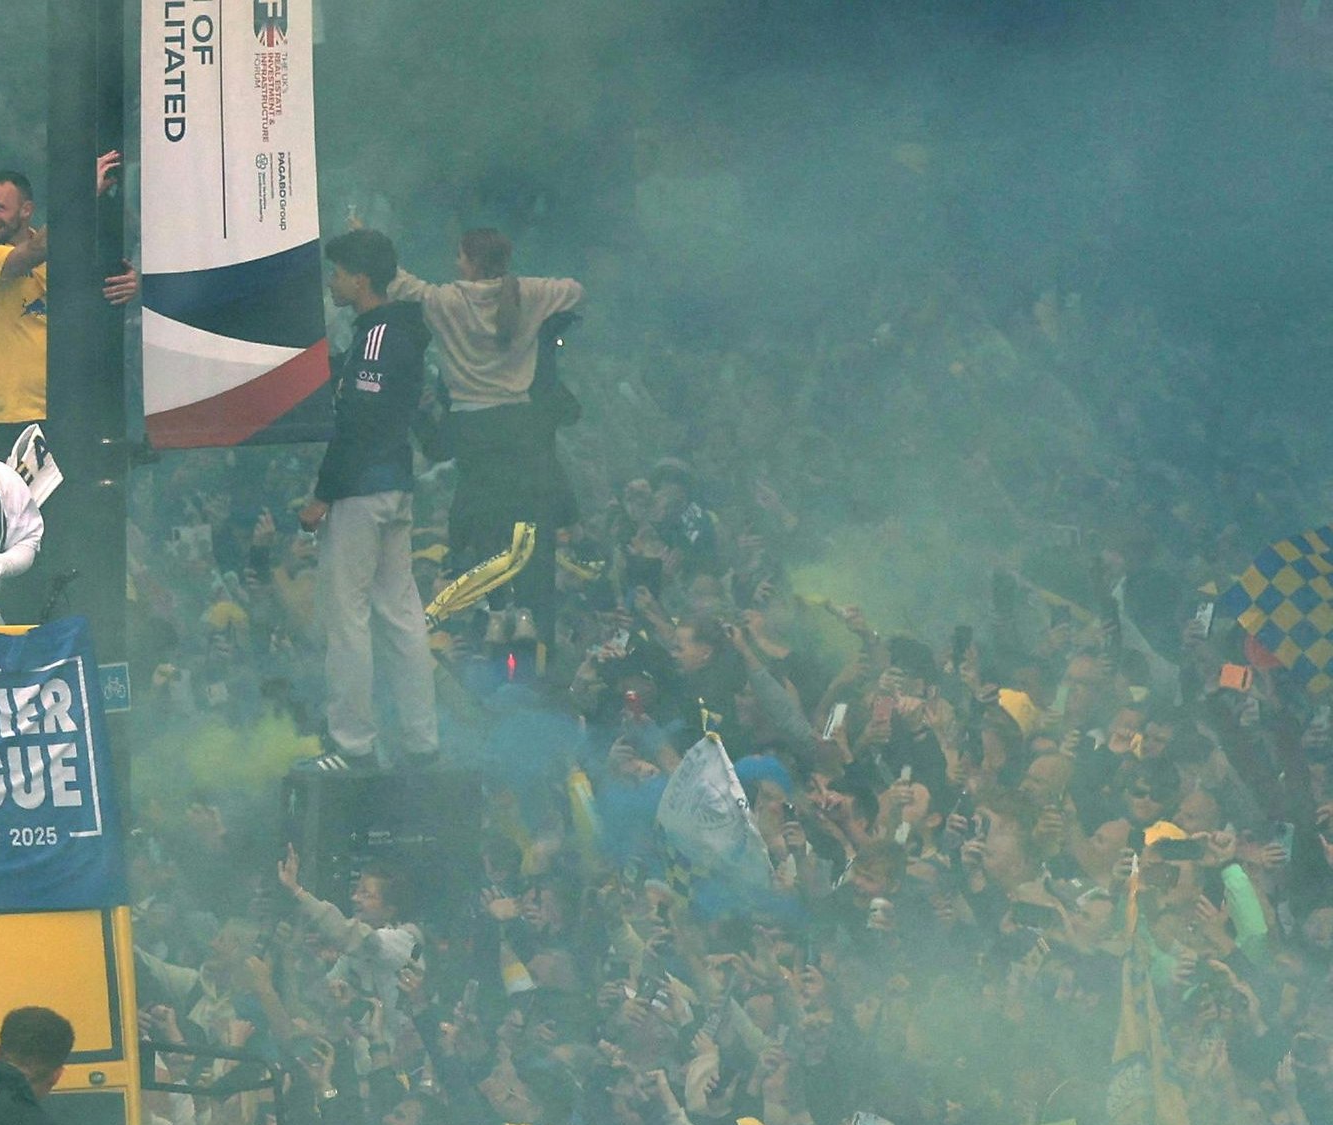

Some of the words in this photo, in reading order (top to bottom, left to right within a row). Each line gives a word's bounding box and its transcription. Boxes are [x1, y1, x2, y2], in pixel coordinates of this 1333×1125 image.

[192, 14, 214, 65] OF
[274, 52, 282, 77] REAL
[261, 52, 269, 143] INFRASTRUCTURE
[279, 199, 287, 231] Group
[359, 370, 383, 382] OXT
[9, 827, 58, 847] 2025
